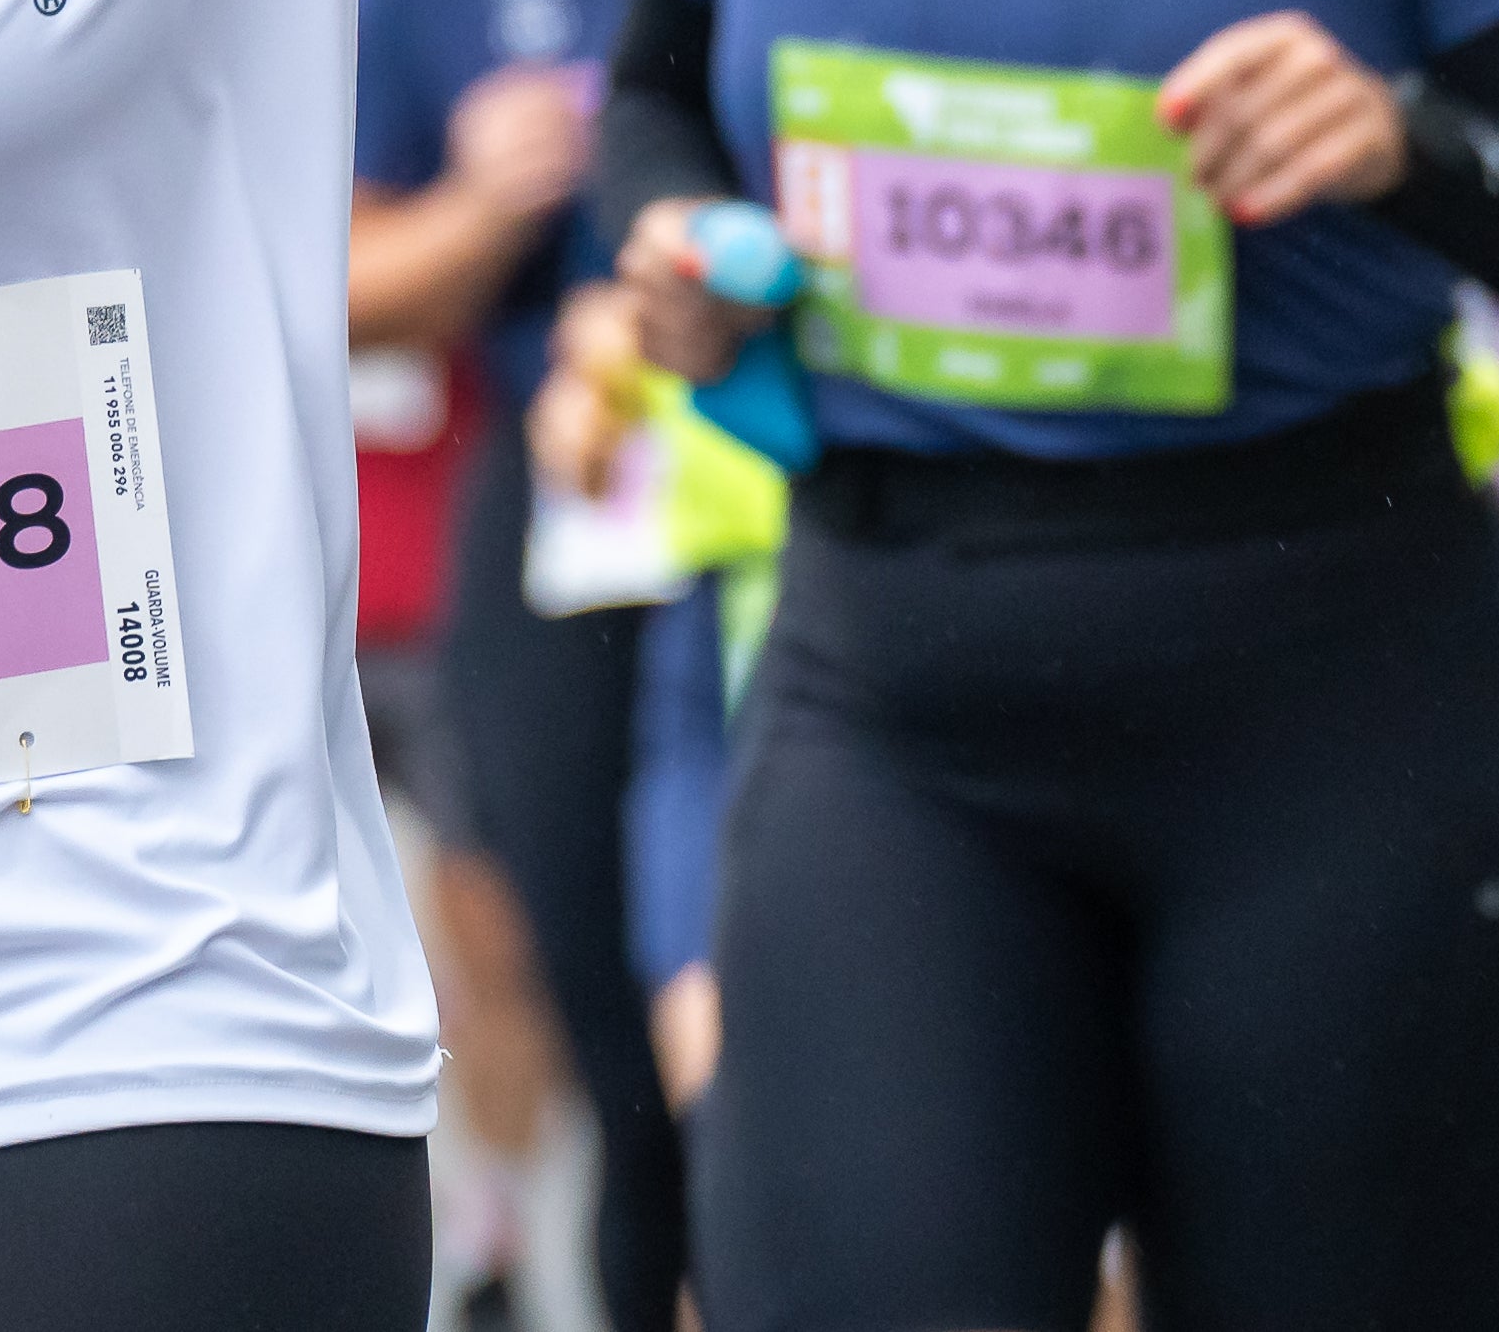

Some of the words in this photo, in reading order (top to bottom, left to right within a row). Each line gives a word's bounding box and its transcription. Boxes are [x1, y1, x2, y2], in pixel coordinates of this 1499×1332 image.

[885, 183, 1160, 275] 10346
[103, 375, 117, 394] 11
[120, 357, 135, 414] TELEFONE
[106, 399, 121, 429] 955
[126, 417, 138, 433] DE
[110, 432, 124, 463] 006
[113, 465, 128, 497] 296
[128, 436, 146, 512] EMERGÊNCIA
[117, 601, 148, 682] 14008
